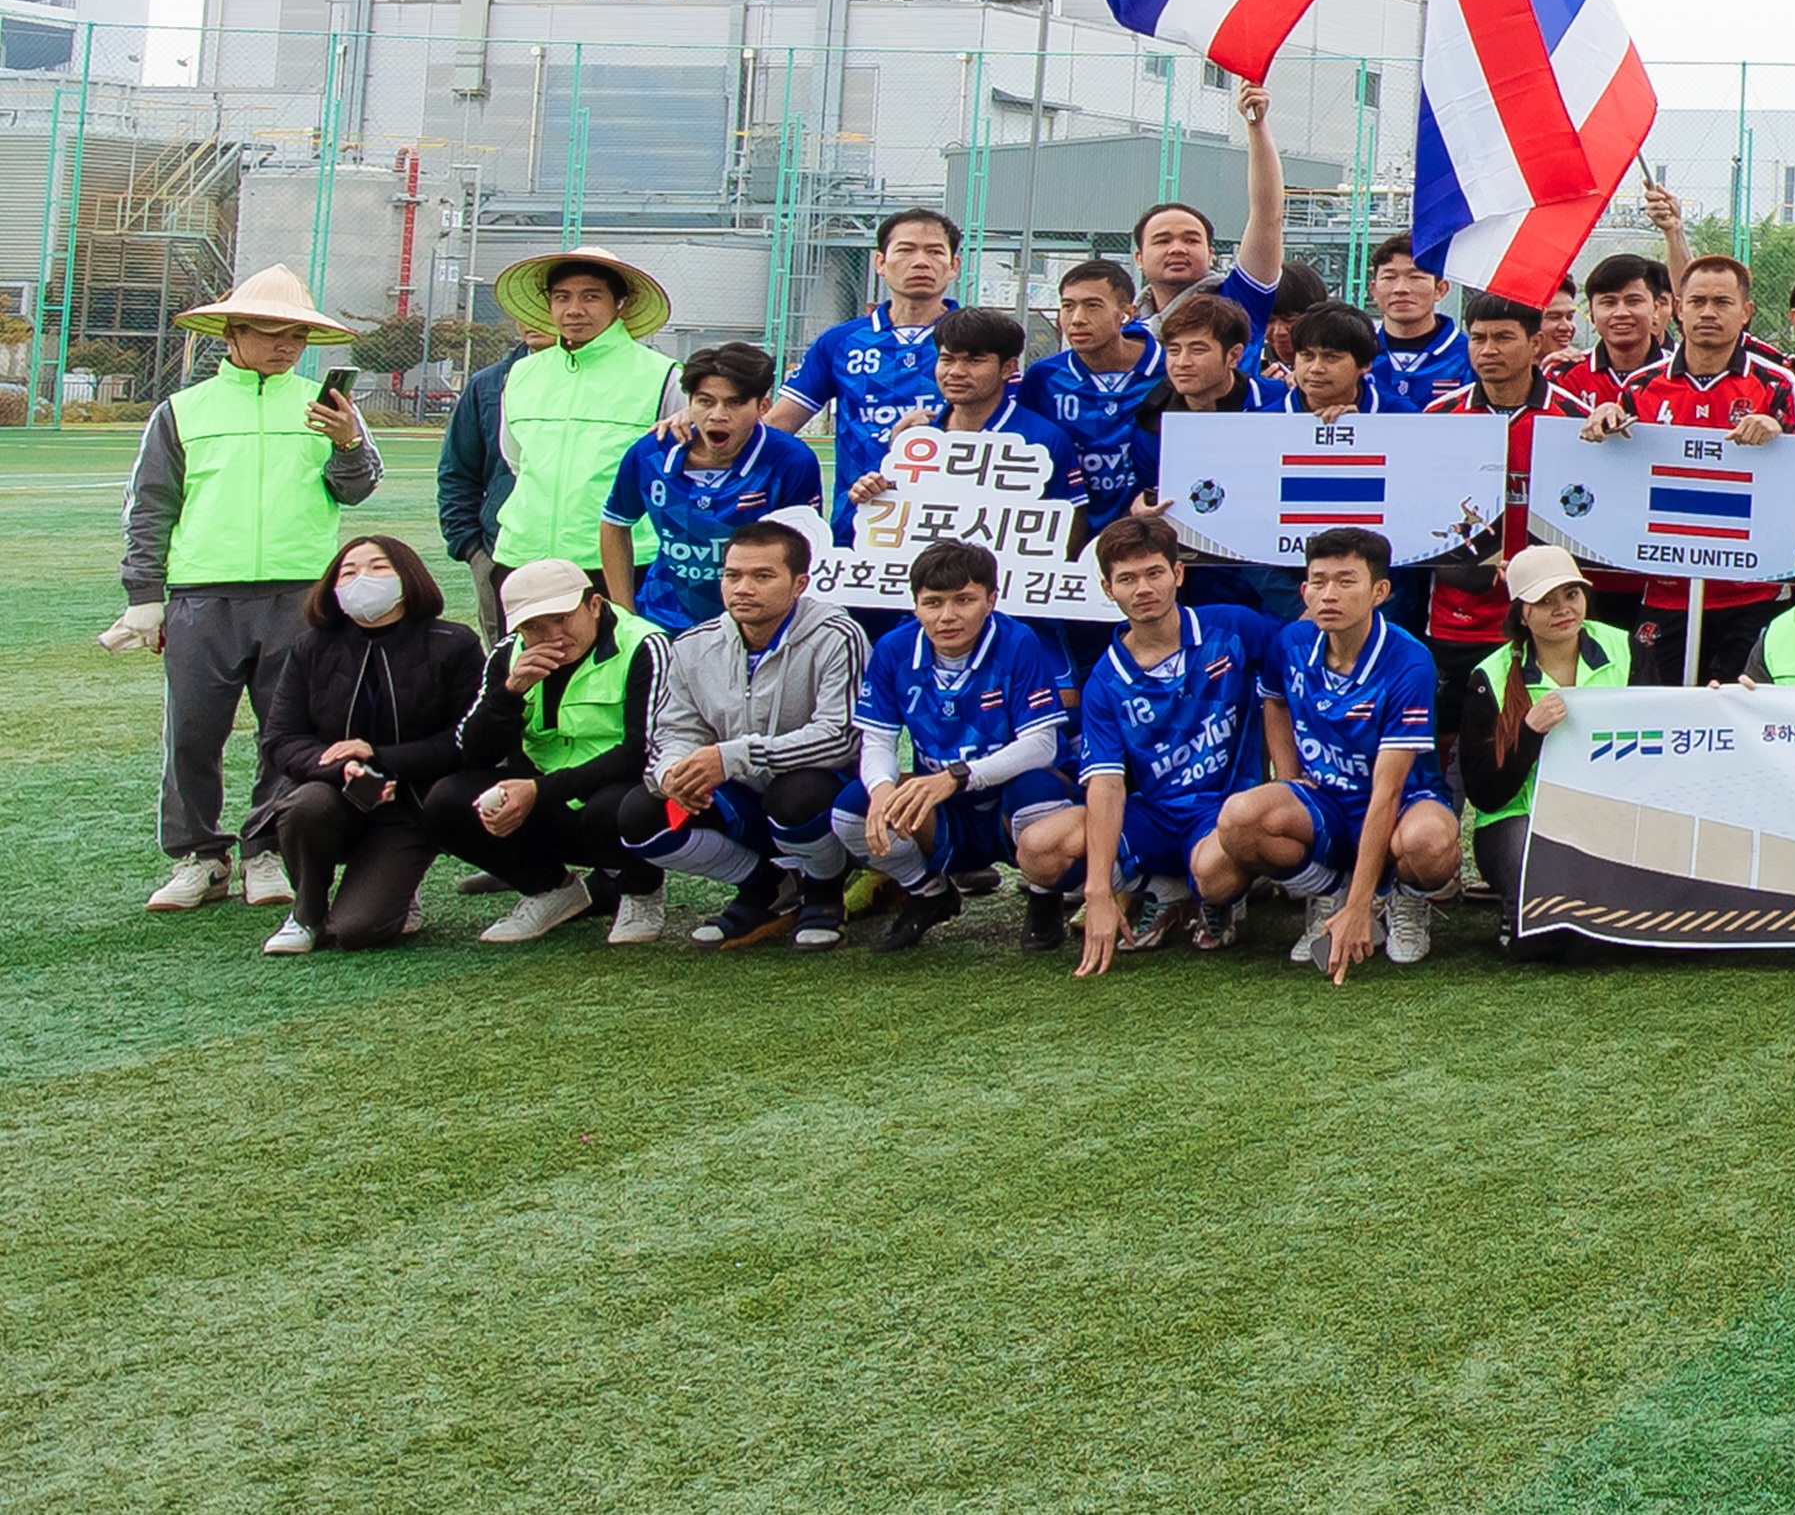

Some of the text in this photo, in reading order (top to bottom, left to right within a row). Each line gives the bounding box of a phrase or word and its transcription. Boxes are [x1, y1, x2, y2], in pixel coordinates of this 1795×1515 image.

[1053, 393, 1079, 421] 10
[1315, 426, 1355, 446] 태국
[1684, 439, 1723, 460] 태국
[893, 437, 1040, 491] 우리는
[867, 499, 1061, 556] 김포시민
[1637, 544, 1758, 569] EZEN UNITED
[1025, 571, 1088, 604] 김포
[906, 685, 922, 714] 7
[1670, 727, 1736, 754] 경기도
